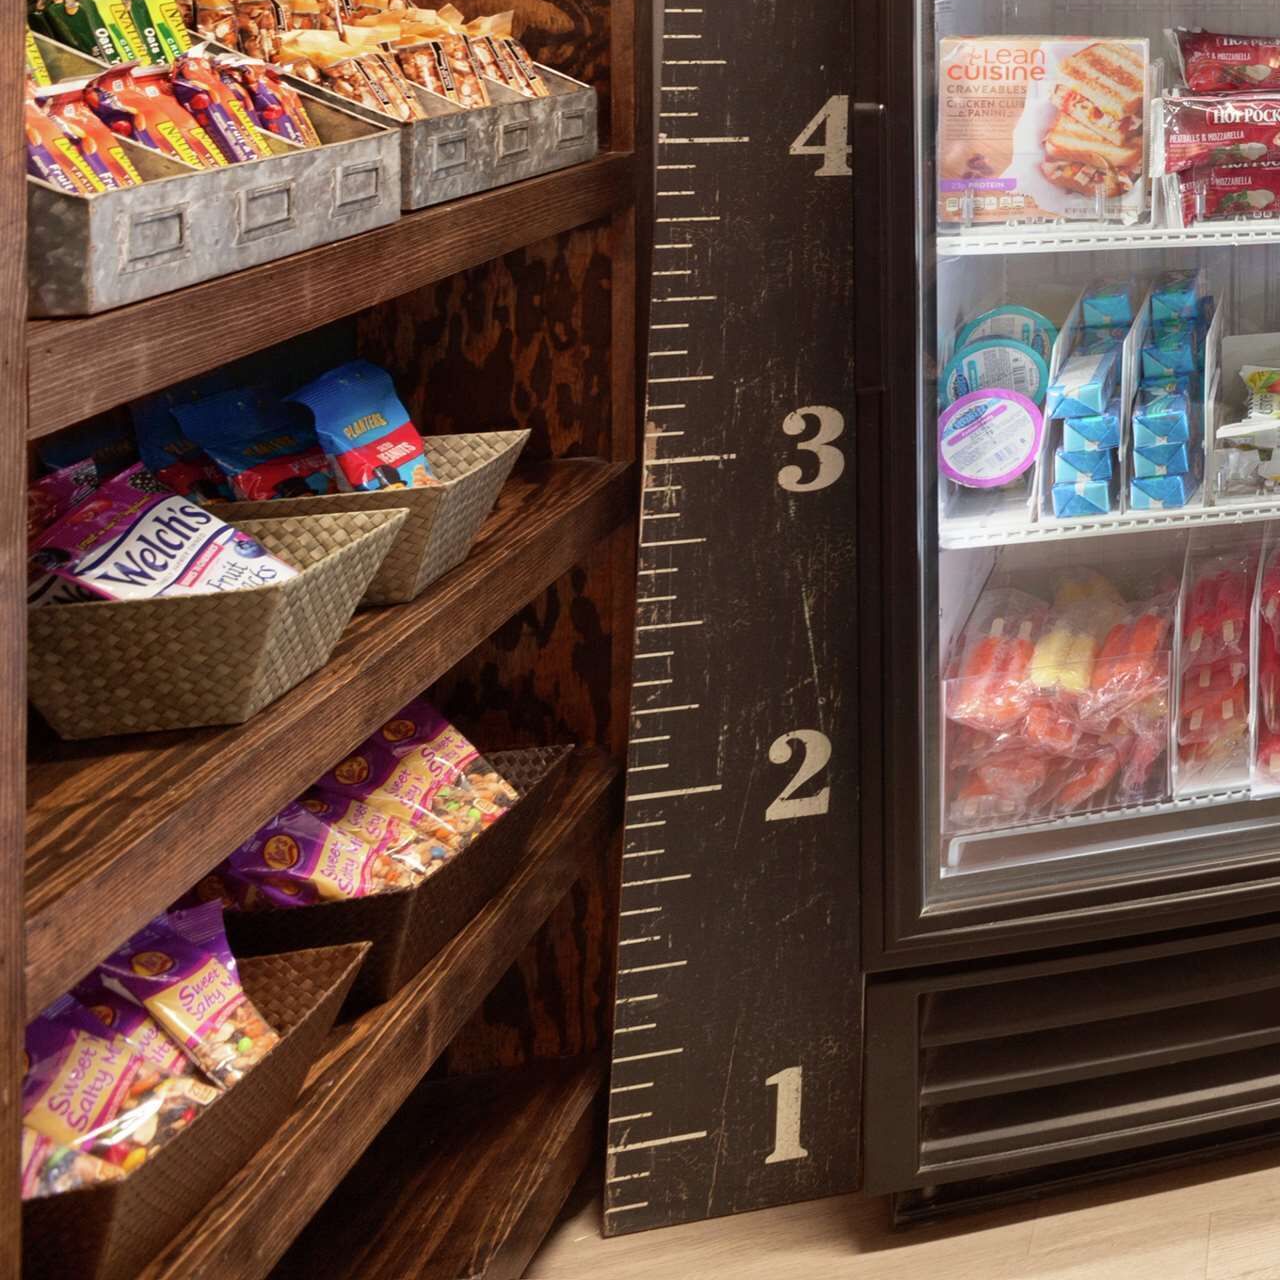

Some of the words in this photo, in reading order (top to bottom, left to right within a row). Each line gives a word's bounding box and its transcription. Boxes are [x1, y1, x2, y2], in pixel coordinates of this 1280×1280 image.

[96, 27, 114, 55] Oats
[143, 27, 160, 55] Oats
[984, 48, 1046, 65] Lean
[946, 84, 1028, 95] CRAVEABLES
[1213, 108, 1245, 124] HOT
[788, 94, 854, 177] 4
[1207, 131, 1245, 142] MOZZARELLA
[48, 163, 74, 191] Fruit
[344, 412, 388, 440] PLANTERS
[777, 405, 846, 493] 3
[94, 503, 212, 588] Welch's
[206, 560, 248, 593] Fruit
[765, 729, 832, 822] 2
[179, 969, 221, 1008] Sweet
[47, 1047, 98, 1117] Sweet
[66, 1069, 111, 1132] Salty
[764, 1067, 808, 1165] 1
